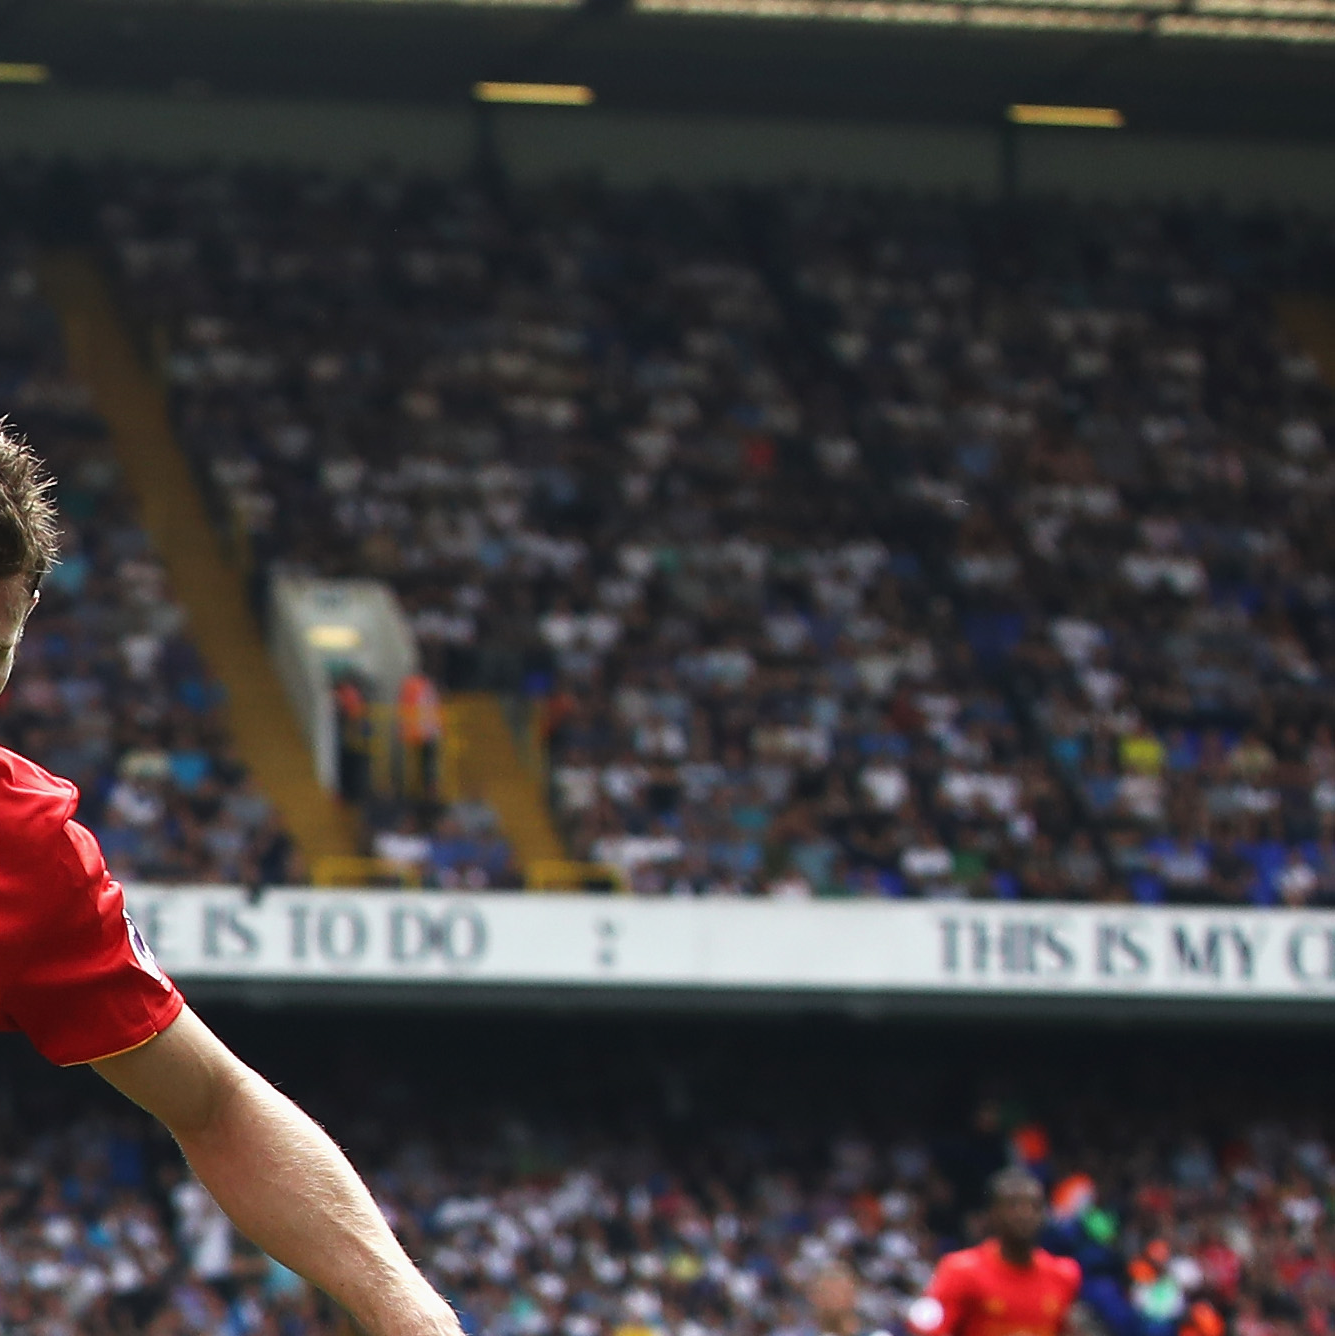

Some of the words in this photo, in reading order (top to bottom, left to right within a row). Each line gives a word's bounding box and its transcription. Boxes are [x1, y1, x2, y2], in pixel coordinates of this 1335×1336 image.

[201, 903, 261, 958] IS
[281, 904, 369, 960] TO
[386, 908, 490, 966] DO
[939, 918, 1075, 972] THIS
[1097, 922, 1151, 974] IS
[1171, 923, 1267, 979] MY
